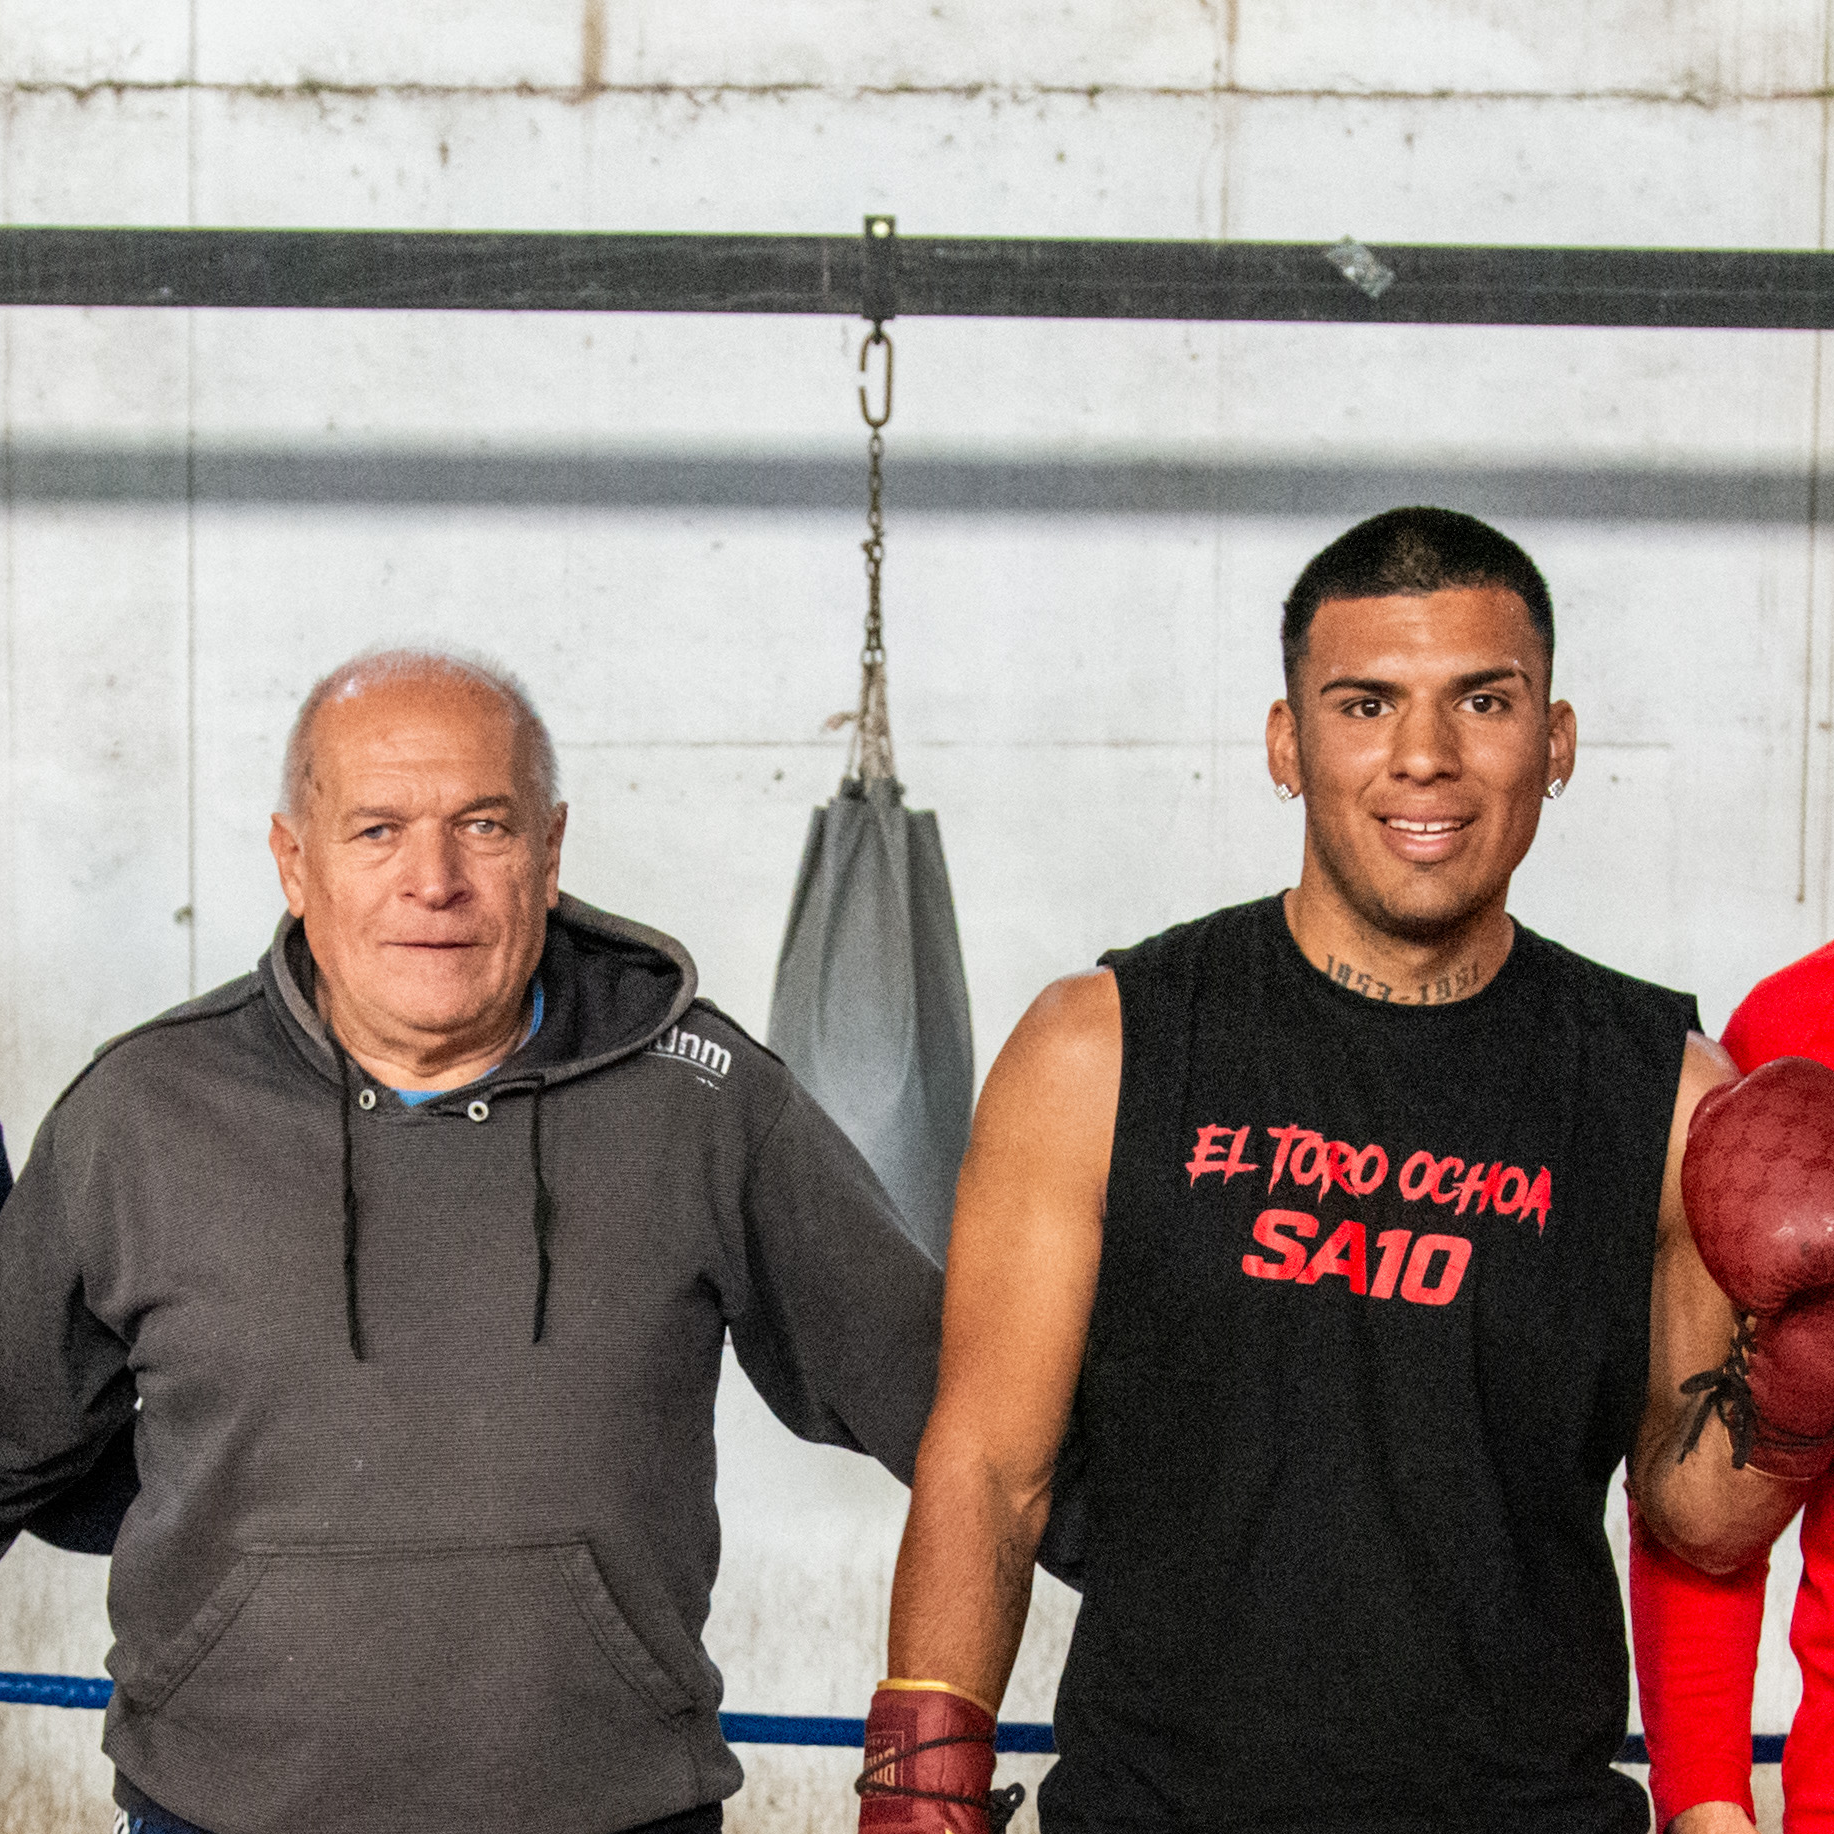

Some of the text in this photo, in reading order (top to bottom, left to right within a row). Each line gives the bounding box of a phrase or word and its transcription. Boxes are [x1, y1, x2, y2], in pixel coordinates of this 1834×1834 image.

[1185, 1123, 1553, 1238] EL TORO OCHOA
[1242, 1208, 1473, 1306] SA10
